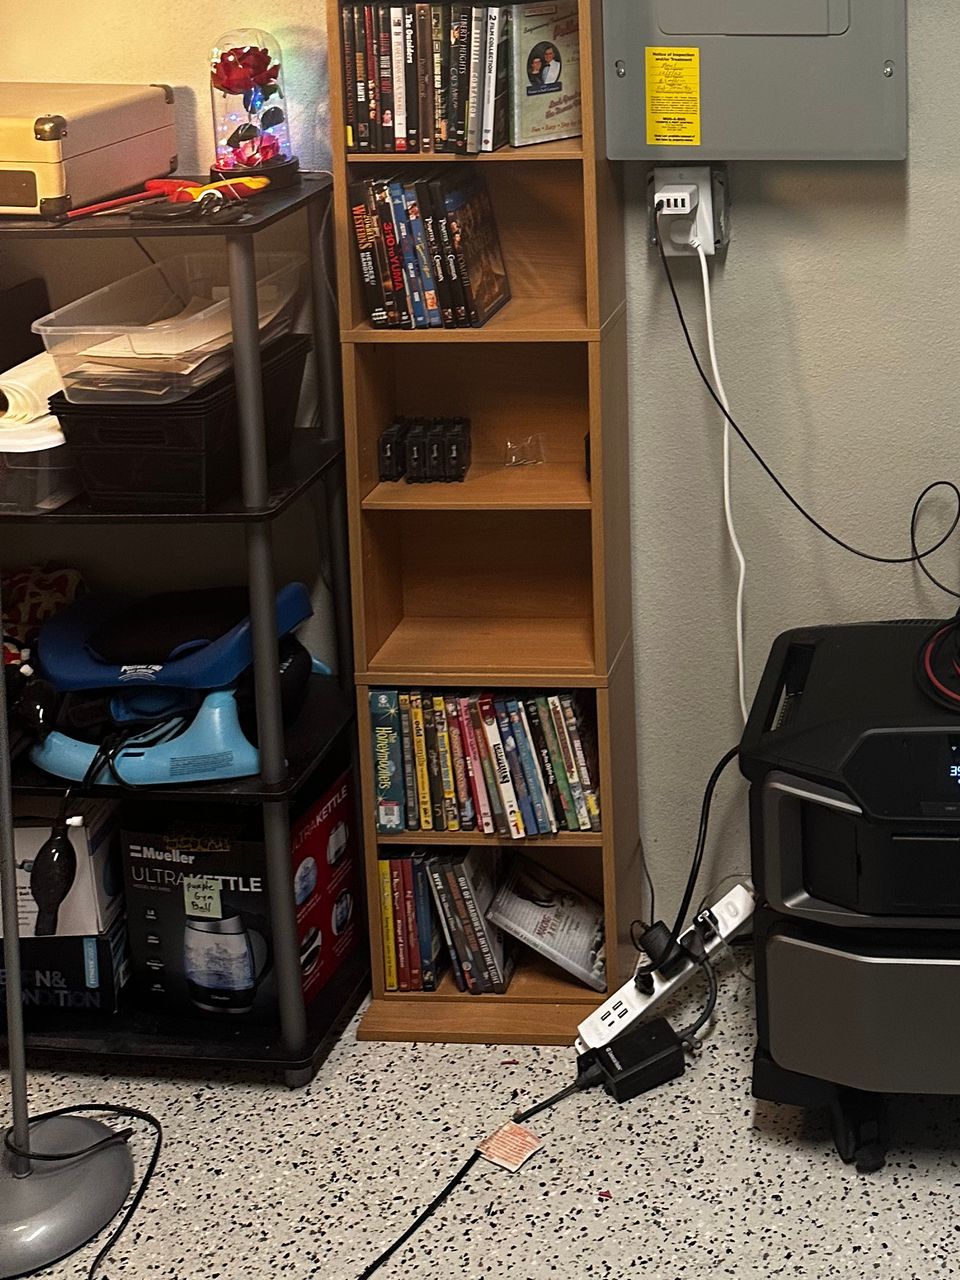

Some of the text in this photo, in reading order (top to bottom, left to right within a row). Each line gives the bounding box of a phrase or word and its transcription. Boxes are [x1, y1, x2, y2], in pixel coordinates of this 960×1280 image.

[405, 14, 415, 64] The Outsiders
[459, 14, 468, 75] LIBERTY HEIGHTS
[487, 36, 495, 74] COLLECTION
[357, 82, 366, 102] SAINTS
[470, 72, 479, 118] CONTAGION
[352, 203, 372, 250] WESTERNS
[389, 256, 404, 291] YUMA
[375, 727, 393, 790] Honeymooners
[143, 847, 195, 864] Mueller
[432, 872, 443, 890] HYPE
[458, 876, 467, 889] OUT
[462, 890, 470, 899] OF
[466, 900, 480, 932] SHADOWS
[536, 914, 552, 938] MAKING
[479, 937, 489, 953] INTO
[483, 953, 493, 966] THE
[488, 966, 500, 985] LIGHT
